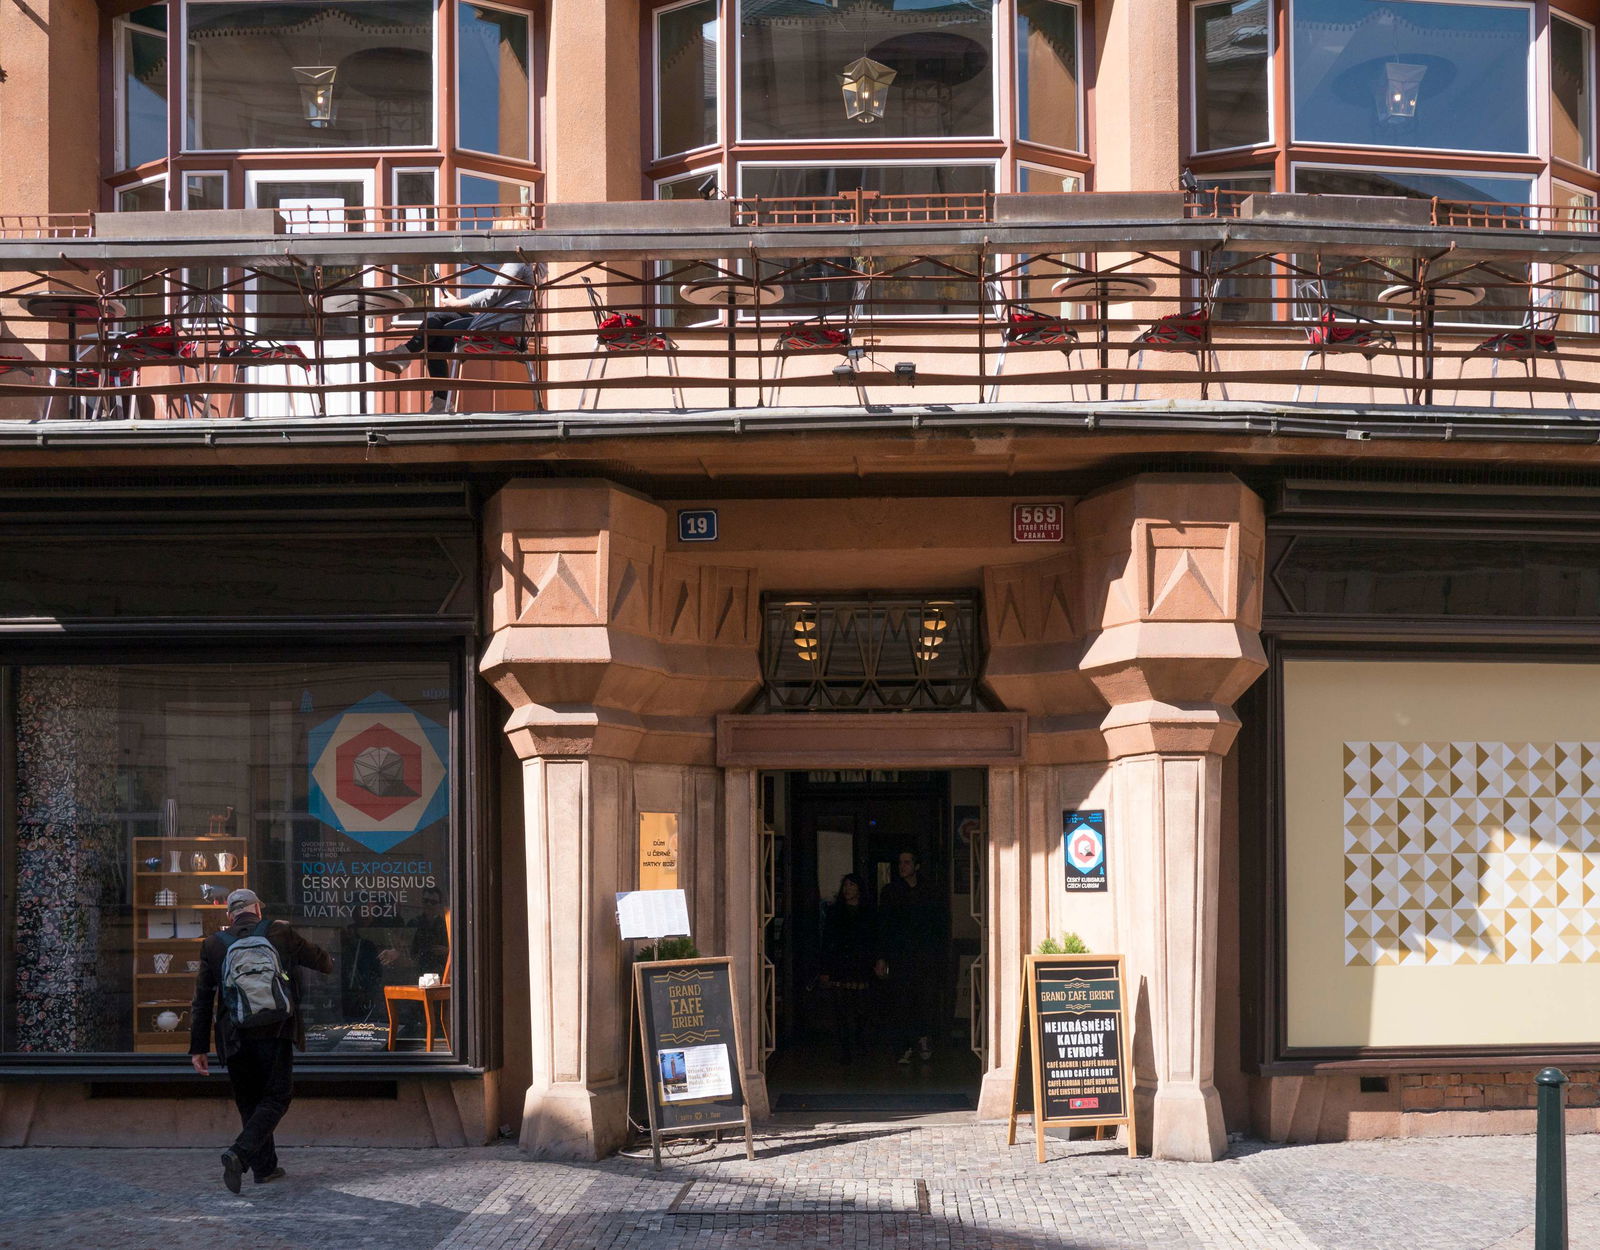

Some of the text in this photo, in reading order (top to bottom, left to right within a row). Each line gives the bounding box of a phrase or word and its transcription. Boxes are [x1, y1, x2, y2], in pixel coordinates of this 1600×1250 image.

[1021, 506, 1056, 523] 569
[687, 517, 708, 534] 19
[302, 861, 433, 875] NOVÁ EXPOZICE!
[302, 874, 436, 889] ČESKÝ KUBISMUS
[343, 891, 354, 903] U
[359, 888, 408, 903] ČERNÉ
[303, 903, 397, 918] MATKY BOŽÍ
[669, 983, 701, 998] GRAND
[1041, 991, 1067, 1002] GRAND
[1089, 990, 1115, 1001] ORIENT
[672, 1015, 705, 1029] ORIENT
[1044, 1018, 1115, 1033] NEJKRÁSNĚJŠÍ
[1057, 1032, 1104, 1046] KAVÁRNY
[1058, 1044, 1105, 1059] V EVROPĚ
[1046, 1060, 1059, 1069] CAFÉ
[1059, 1060, 1079, 1069] SACHER
[1051, 1067, 1114, 1079] GRAND CAFÉ ORIENT
[1062, 1079, 1081, 1087] FLORIAN
[1083, 1078, 1095, 1086] CAFÉ
[1095, 1078, 1106, 1086] NEW
[1106, 1077, 1119, 1085] YORK
[1048, 1085, 1120, 1096] CAFÉ EINSTEIN CAFÉ DE LA PAIX
